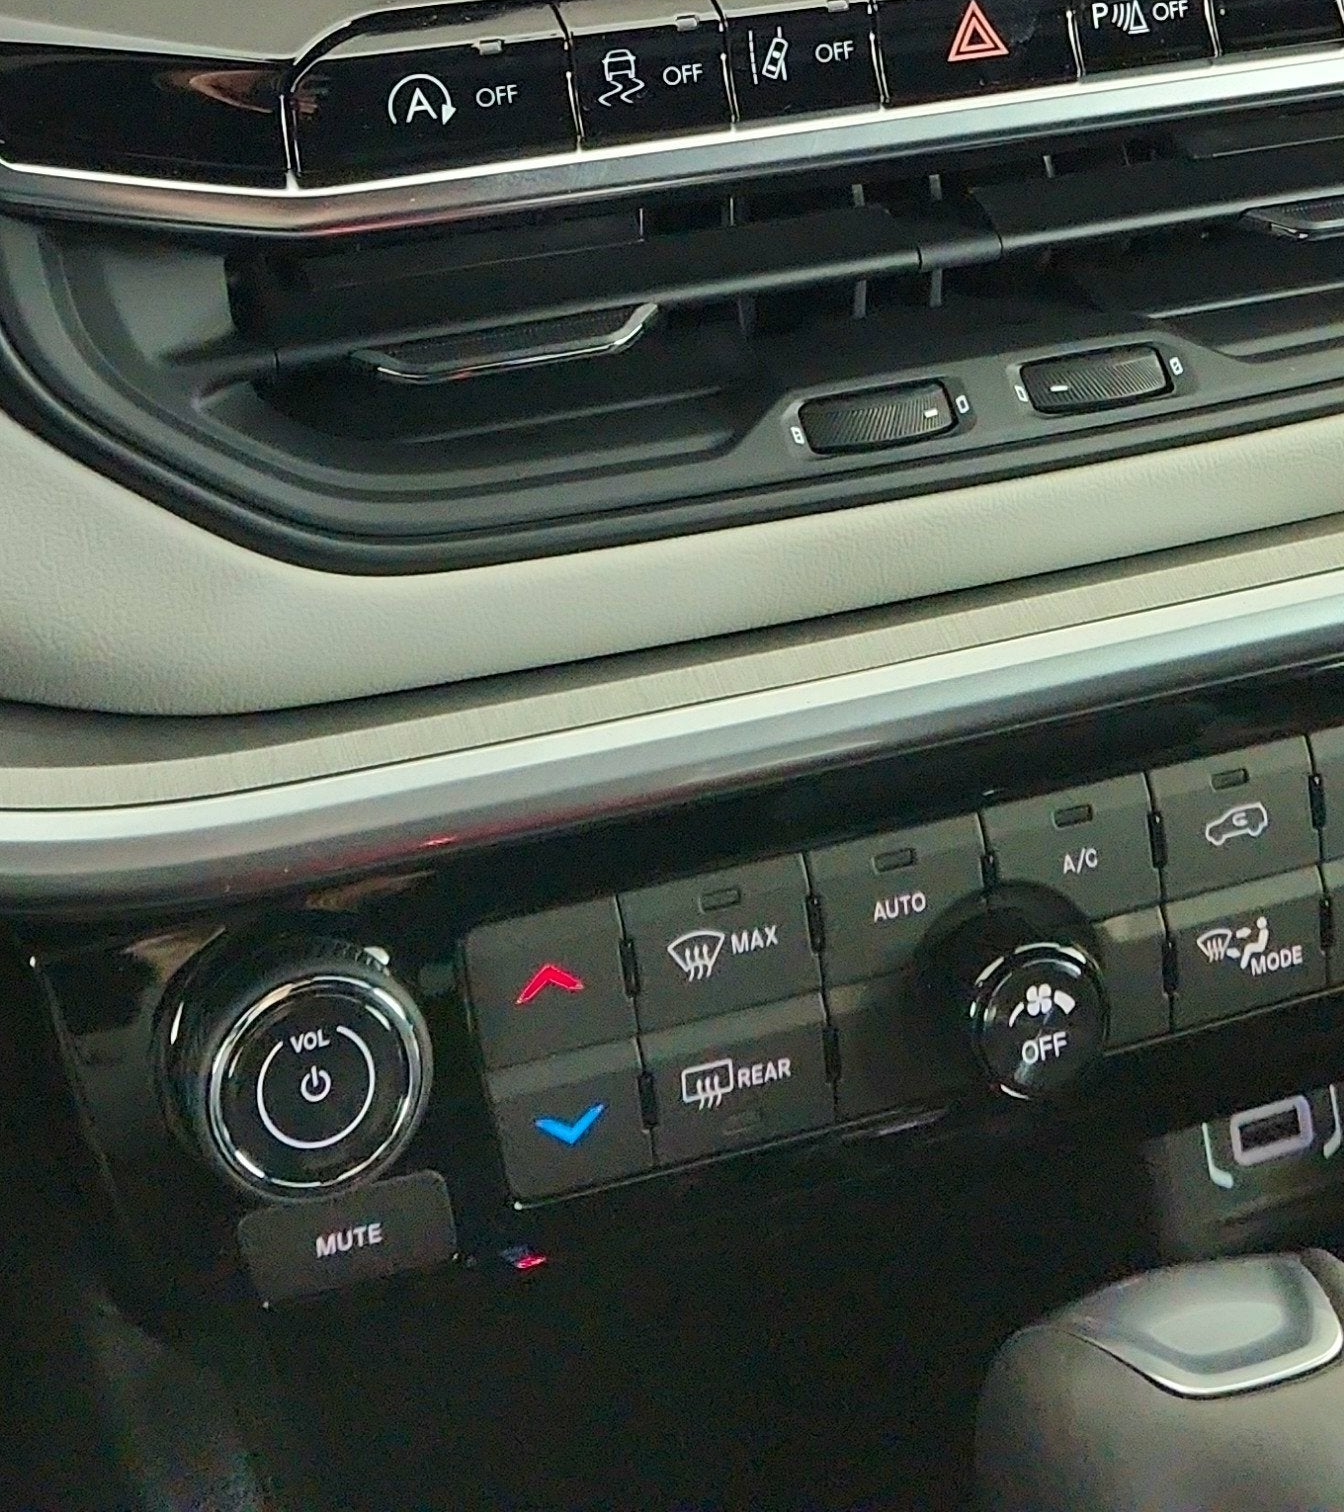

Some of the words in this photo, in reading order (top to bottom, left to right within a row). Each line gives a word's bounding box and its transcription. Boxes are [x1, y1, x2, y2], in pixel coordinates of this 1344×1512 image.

[1092, 3, 1108, 29] P
[1153, 0, 1188, 22] OFF
[815, 40, 855, 63] OFF
[663, 63, 704, 86] OFF
[476, 85, 518, 108] OFF
[1063, 848, 1099, 877] A/C
[872, 890, 927, 923] AUTO
[731, 925, 779, 955] MAX
[1250, 946, 1304, 976] MODE
[290, 1030, 330, 1054] VOL
[1021, 1031, 1069, 1066] OFF
[737, 1058, 792, 1089] REAR
[315, 1222, 383, 1258] MUTE
